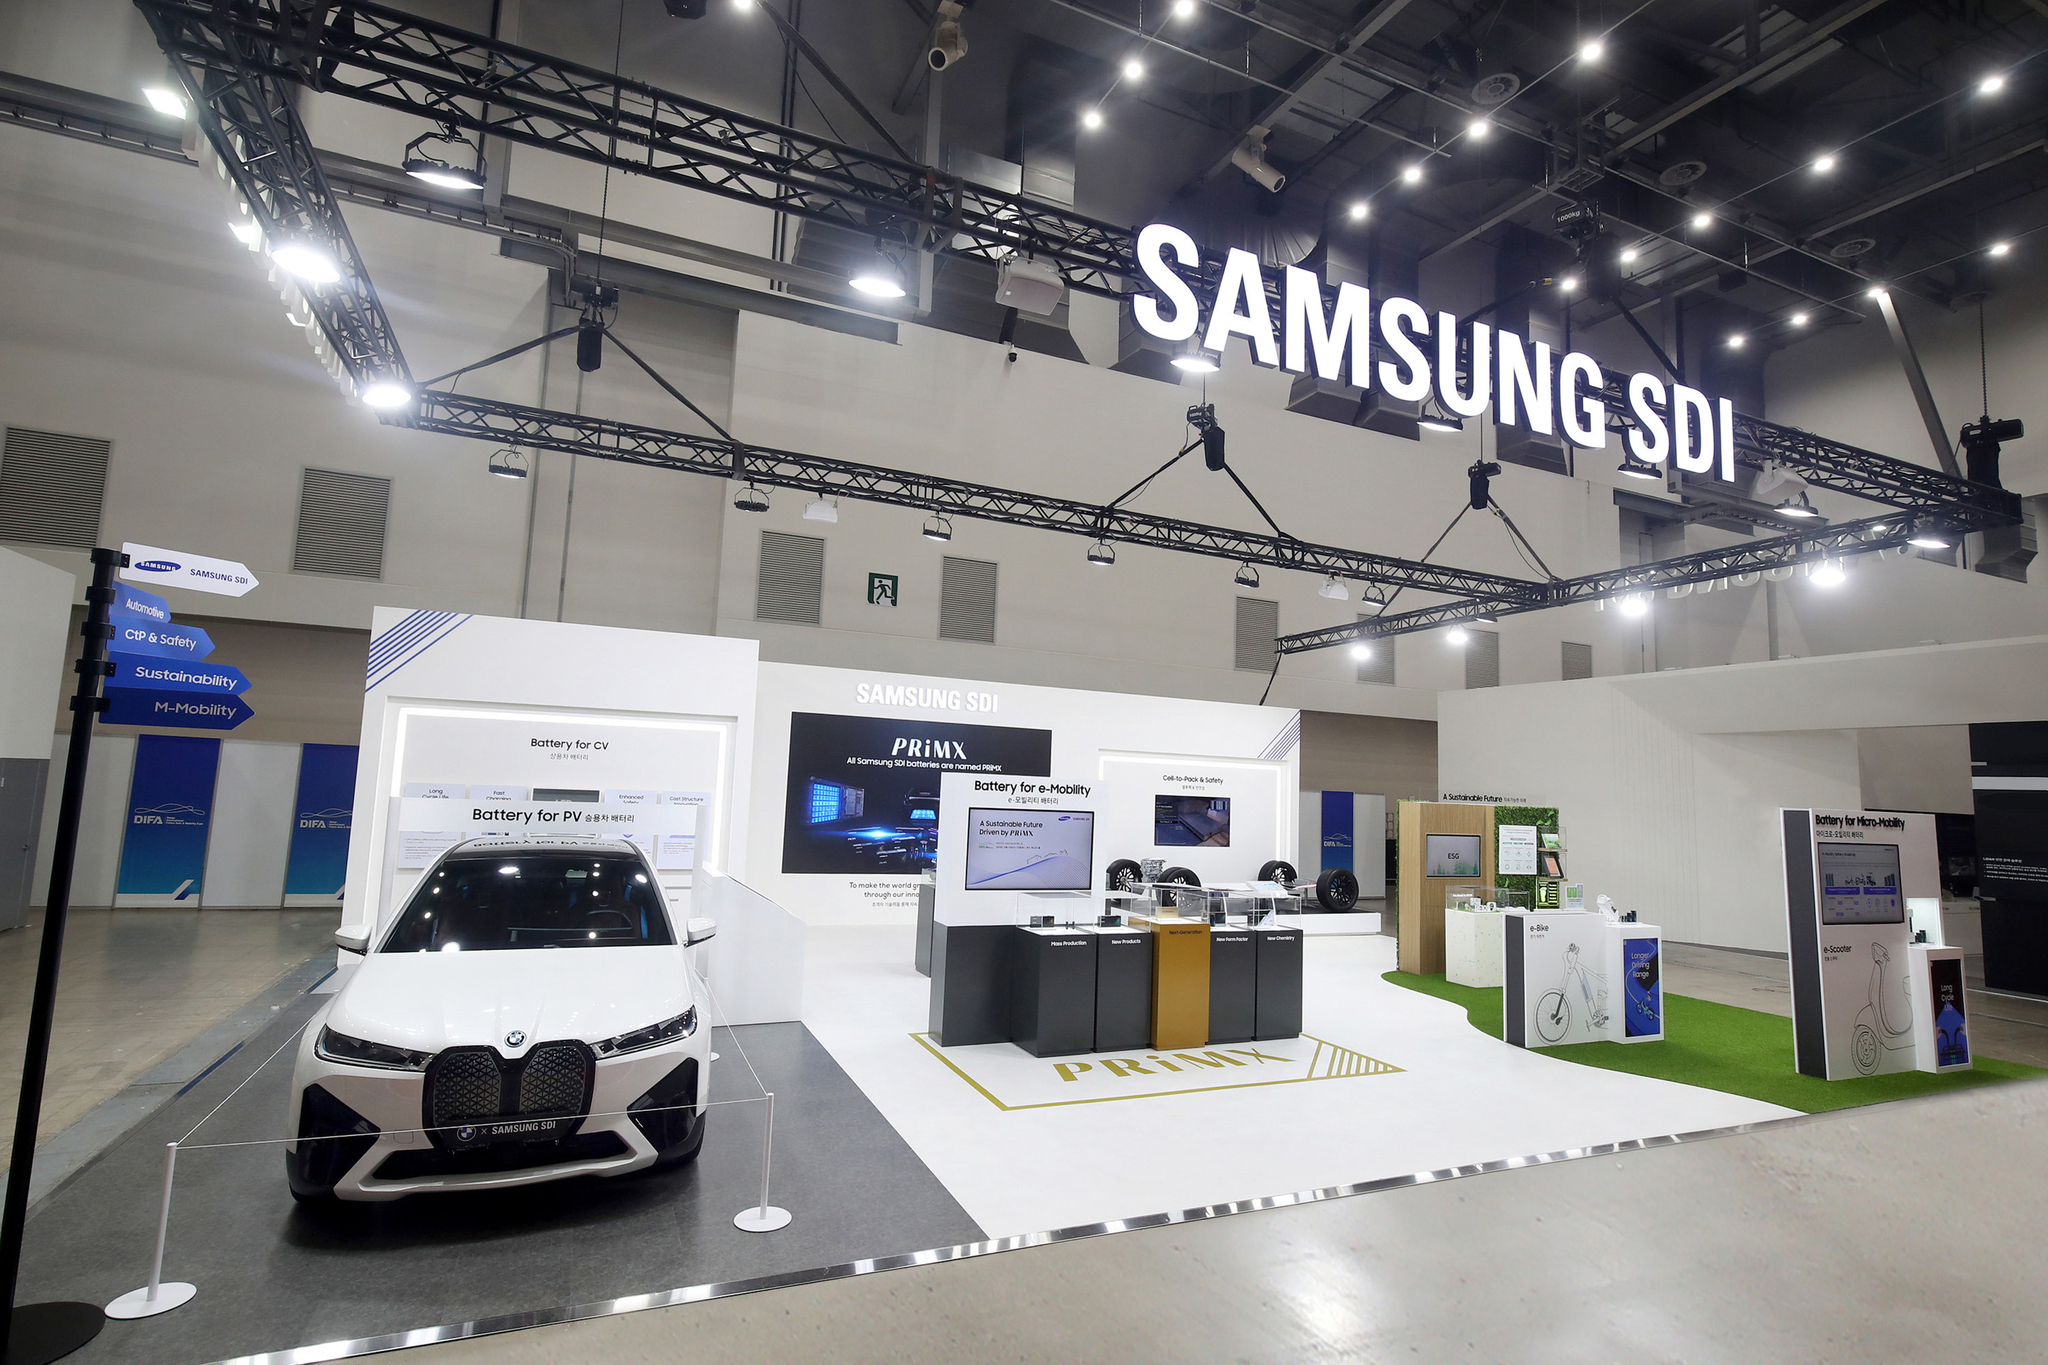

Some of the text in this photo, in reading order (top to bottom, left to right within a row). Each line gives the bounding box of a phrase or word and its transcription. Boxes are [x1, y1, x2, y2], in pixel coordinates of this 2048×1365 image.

[1557, 210, 1580, 222] 1000kg
[1132, 222, 1735, 482] SAMSUNG SDI
[140, 561, 176, 571] SAMSUNG
[190, 568, 248, 585] SAMSUNG SDI
[126, 598, 164, 619] Automotive
[125, 629, 197, 651] CtP & Safety
[135, 666, 238, 690] Sustainability
[857, 683, 998, 713] SAMSUNG SDI
[154, 701, 237, 719] M-Mobility
[531, 738, 609, 751] Battery for CV
[891, 737, 967, 760] PRiMX
[857, 757, 893, 769] Samsung
[907, 760, 940, 769] batteries
[956, 763, 981, 771] named
[1205, 777, 1224, 785] Safety
[974, 780, 1091, 798] Battery for e-Mobility
[1041, 797, 1059, 805] 배터리
[1449, 794, 1483, 802] Sustainable
[134, 815, 163, 824] DIFA
[473, 809, 582, 825] Battery for PV
[585, 814, 634, 823] 승용차 배터리
[1815, 815, 1905, 831] Battery for Micro-Mobility
[300, 819, 326, 828] DIFA
[864, 891, 891, 900] through
[1530, 924, 1549, 932] e-Bike
[1824, 945, 1852, 954] e-Scooter
[1632, 961, 1649, 970] Driving
[1632, 971, 1649, 980] Range
[1940, 984, 1953, 993] Long
[1941, 994, 1954, 1002] Cycle
[492, 1122, 539, 1135] SAMSUNG
[541, 1120, 556, 1130] SDI
